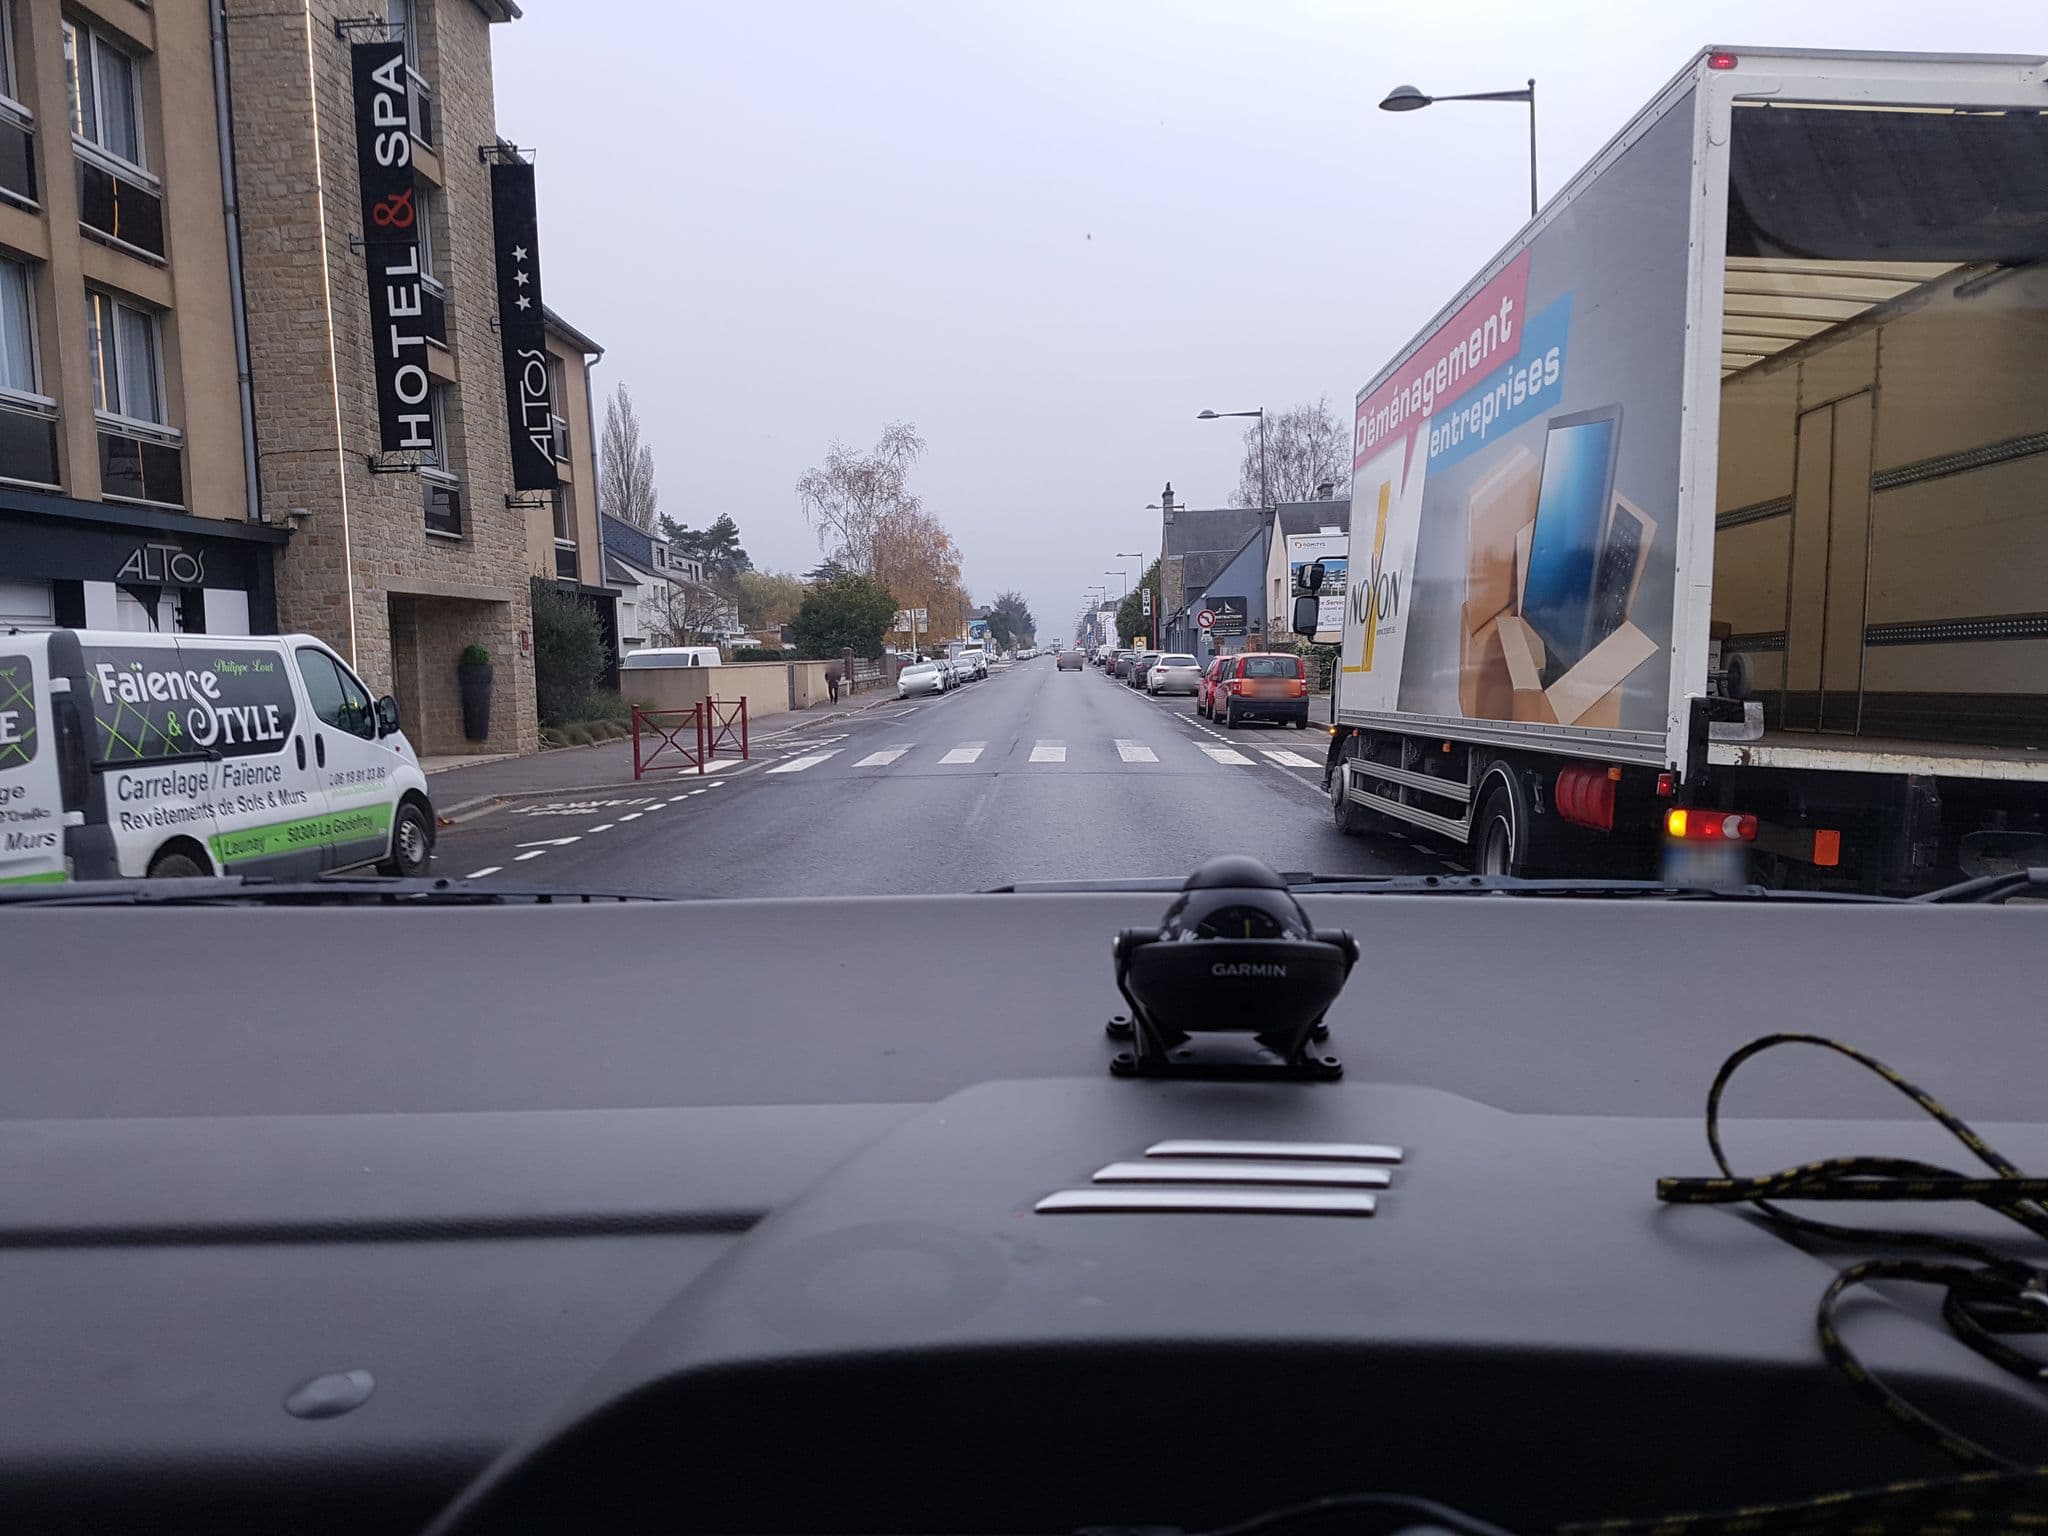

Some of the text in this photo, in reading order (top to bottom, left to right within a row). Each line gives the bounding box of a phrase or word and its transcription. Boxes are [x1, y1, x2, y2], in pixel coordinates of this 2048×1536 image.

[372, 54, 433, 448] HOTEL & SPA
[1355, 295, 1513, 458] Déménagement
[518, 349, 555, 467] ALTOS
[1429, 346, 1560, 459] entreprises
[115, 543, 205, 583] ALTOS
[1143, 589, 1151, 614] SIMA
[1349, 562, 1403, 628] NOYON
[96, 661, 222, 705] Faïence
[167, 710, 183, 737] &
[187, 696, 285, 747] STYLE
[118, 769, 209, 801] Carrelage
[223, 762, 282, 789] Faïence
[119, 787, 309, 832] Revêtements de Sols & Murs
[4, 831, 58, 852] Murs
[1211, 962, 1287, 977] GARMIN
